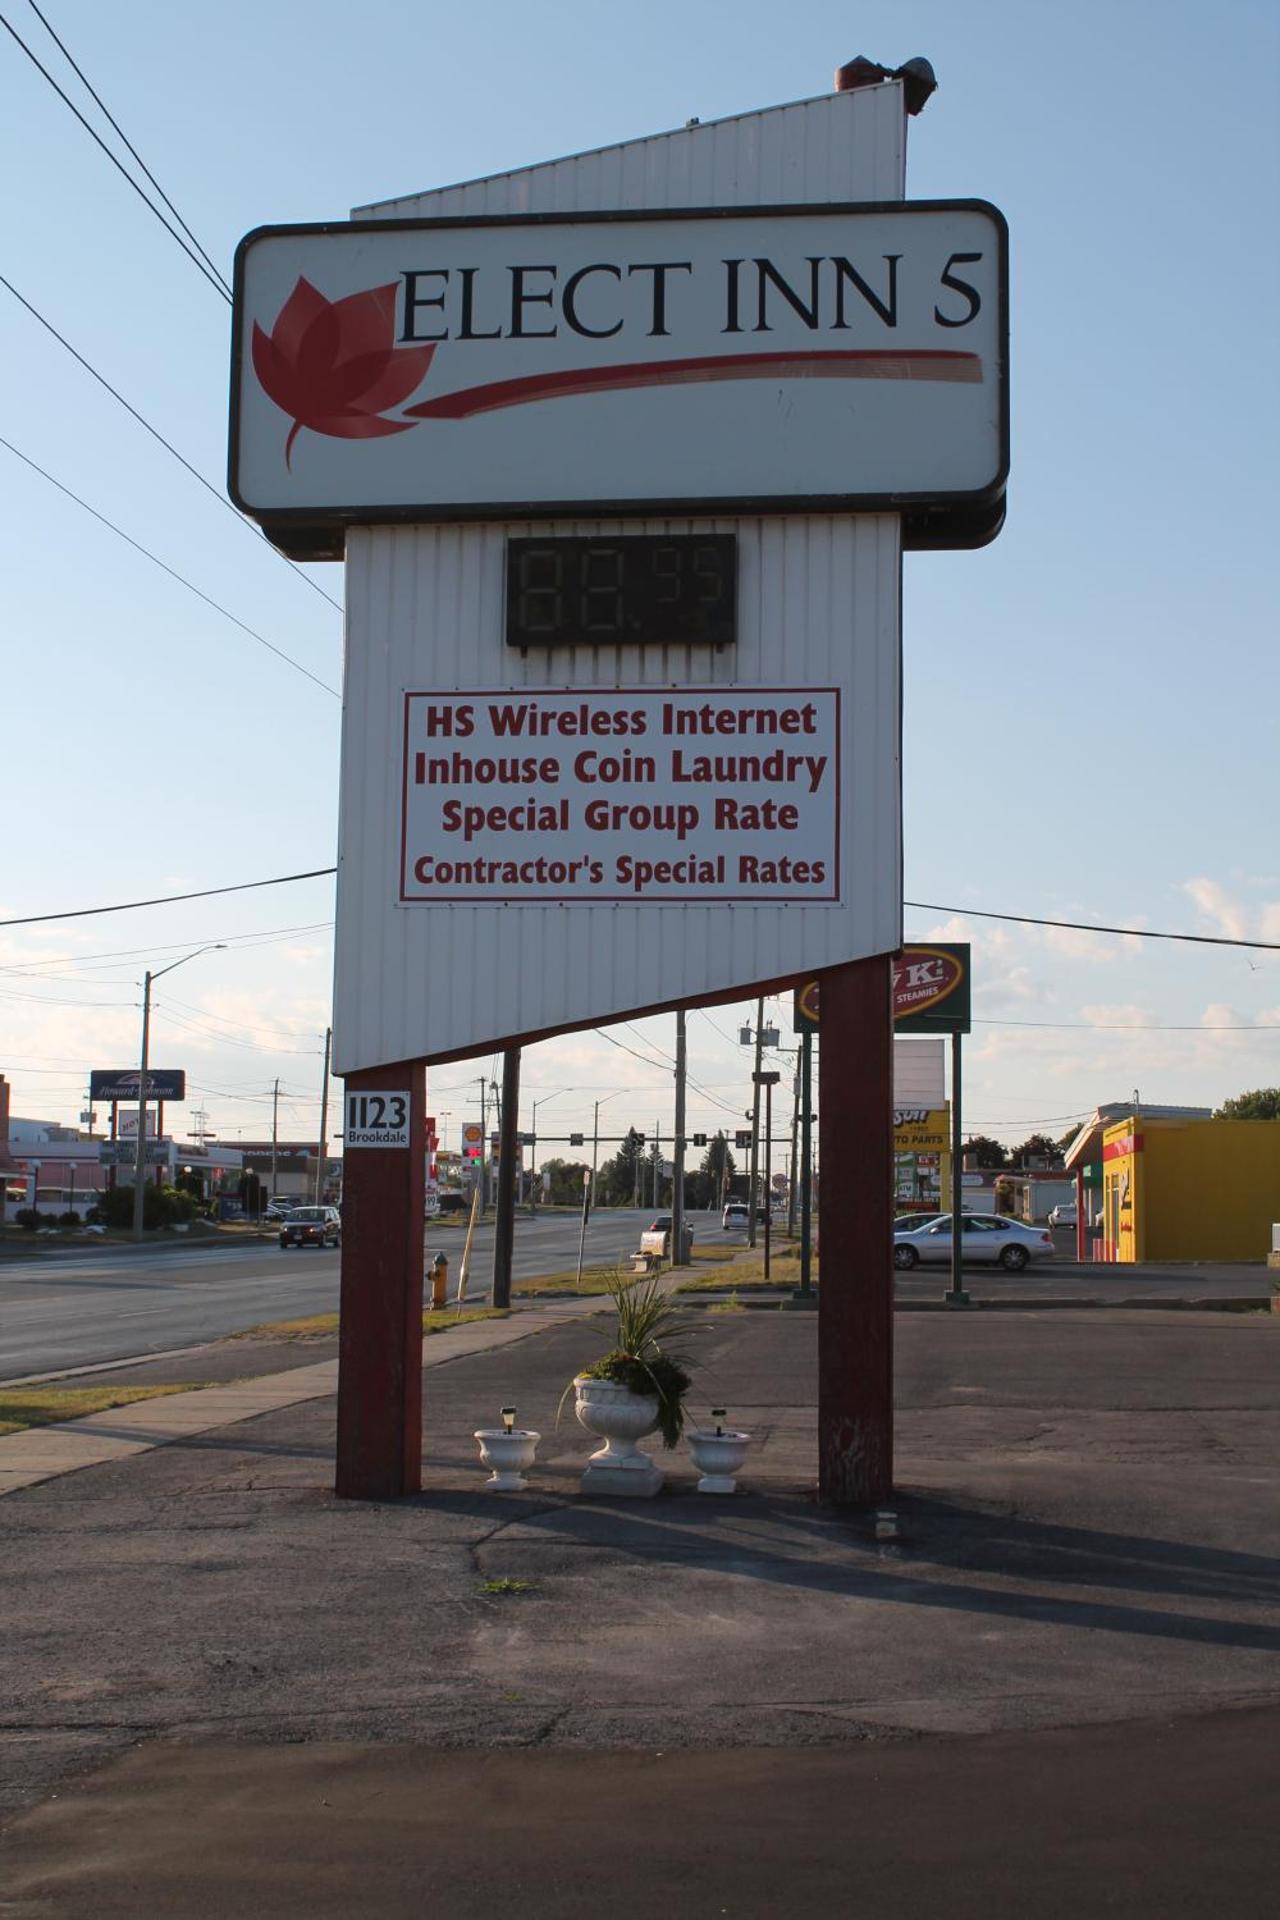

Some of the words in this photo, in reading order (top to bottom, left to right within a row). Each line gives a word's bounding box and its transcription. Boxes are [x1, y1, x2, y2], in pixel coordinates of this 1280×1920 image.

[398, 261, 692, 341] ELECT
[721, 254, 903, 333] INN
[933, 252, 983, 328] 5
[426, 705, 475, 738] HS
[488, 703, 647, 737] Wireless
[662, 703, 817, 735] Internet
[415, 751, 560, 785] Inhouse
[574, 748, 656, 784] Coin
[671, 749, 828, 793] Laundry
[442, 797, 569, 842] Special
[584, 799, 700, 841] Group
[714, 798, 799, 831] Rate
[414, 854, 604, 884] Contractor's
[615, 854, 725, 893] Special
[738, 855, 825, 884] Rates
[896, 986, 939, 1004] STEAMIES
[349, 1096, 407, 1130] 1123
[348, 1131, 407, 1143] Brookdale
[911, 1135, 943, 1145] PARTS
